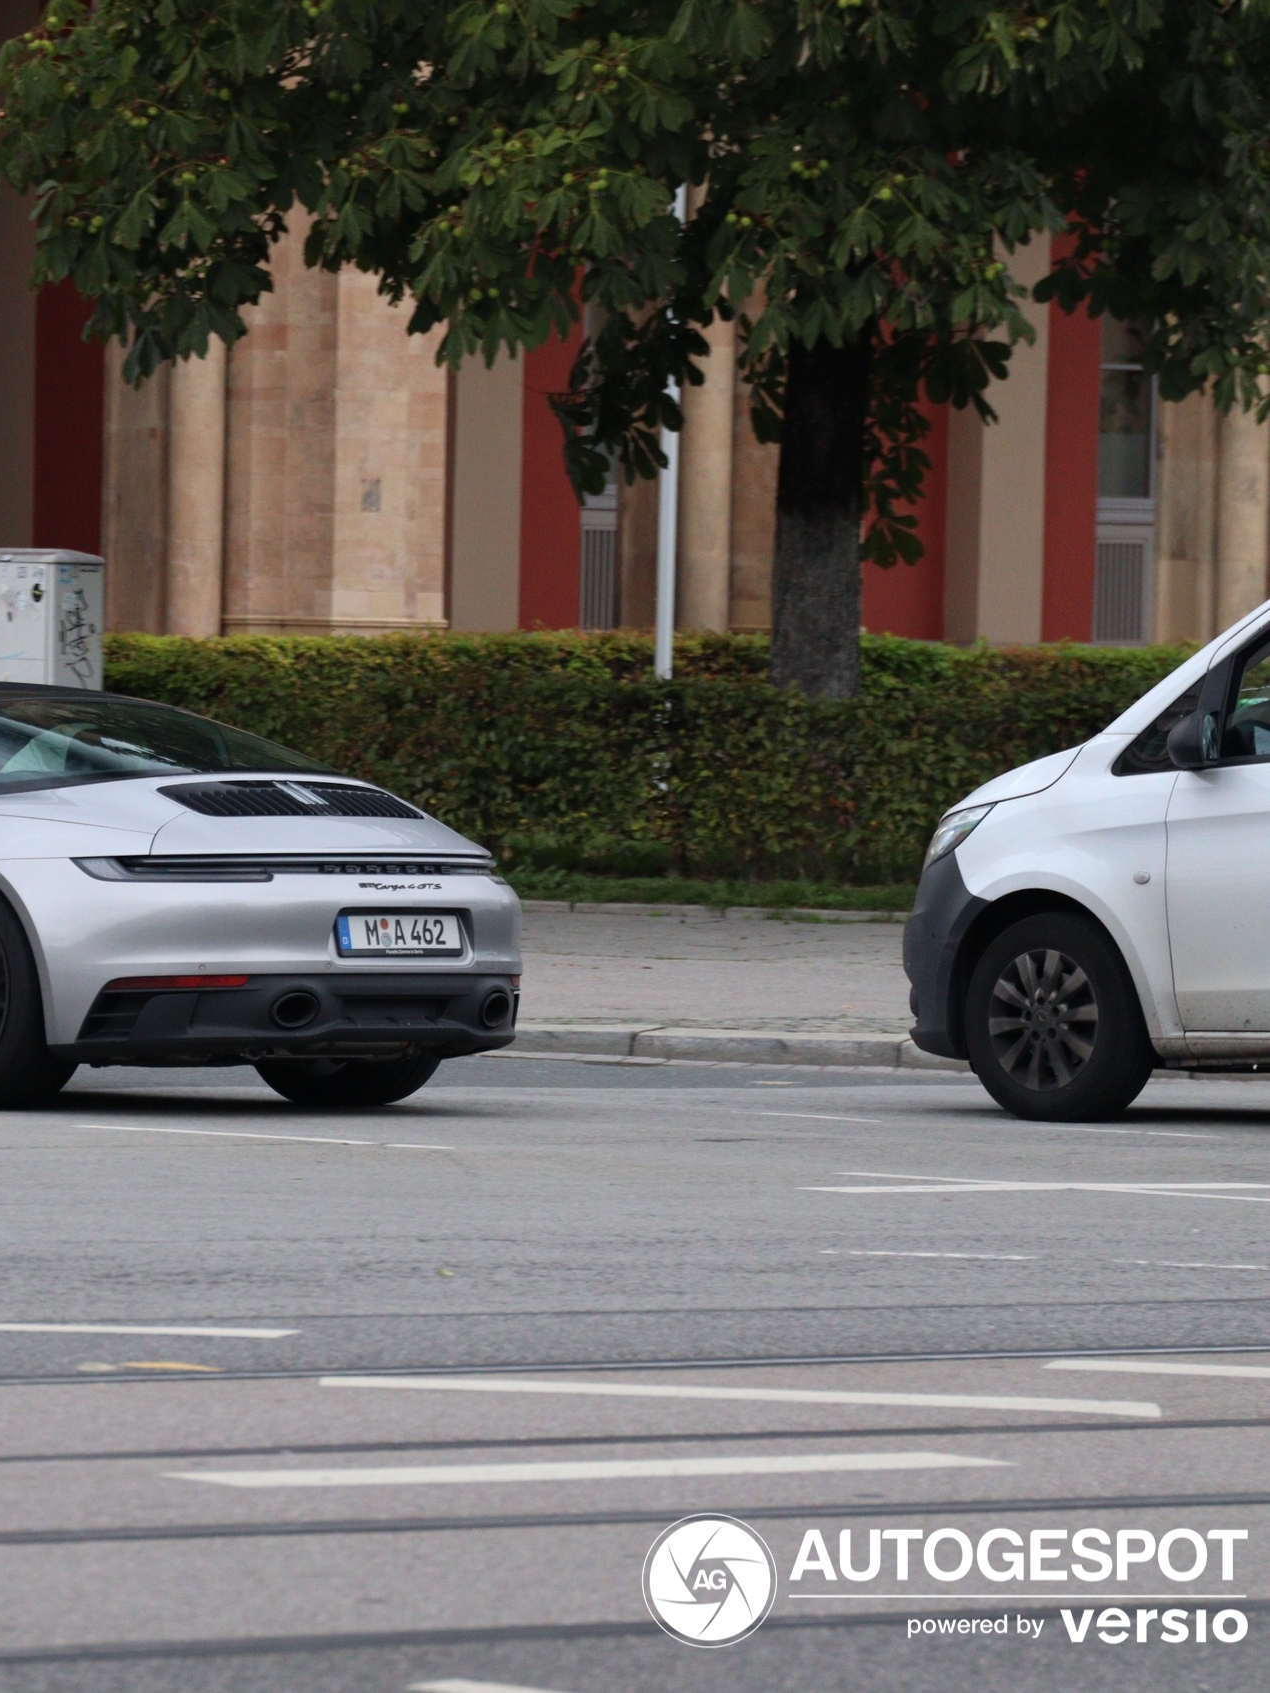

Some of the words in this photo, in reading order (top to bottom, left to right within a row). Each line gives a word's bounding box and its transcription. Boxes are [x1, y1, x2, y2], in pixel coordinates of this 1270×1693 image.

[323, 864, 452, 875] PORSCHE
[375, 883, 406, 891] Targa
[364, 919, 381, 946] M
[394, 919, 407, 946] A
[410, 919, 447, 946] 462
